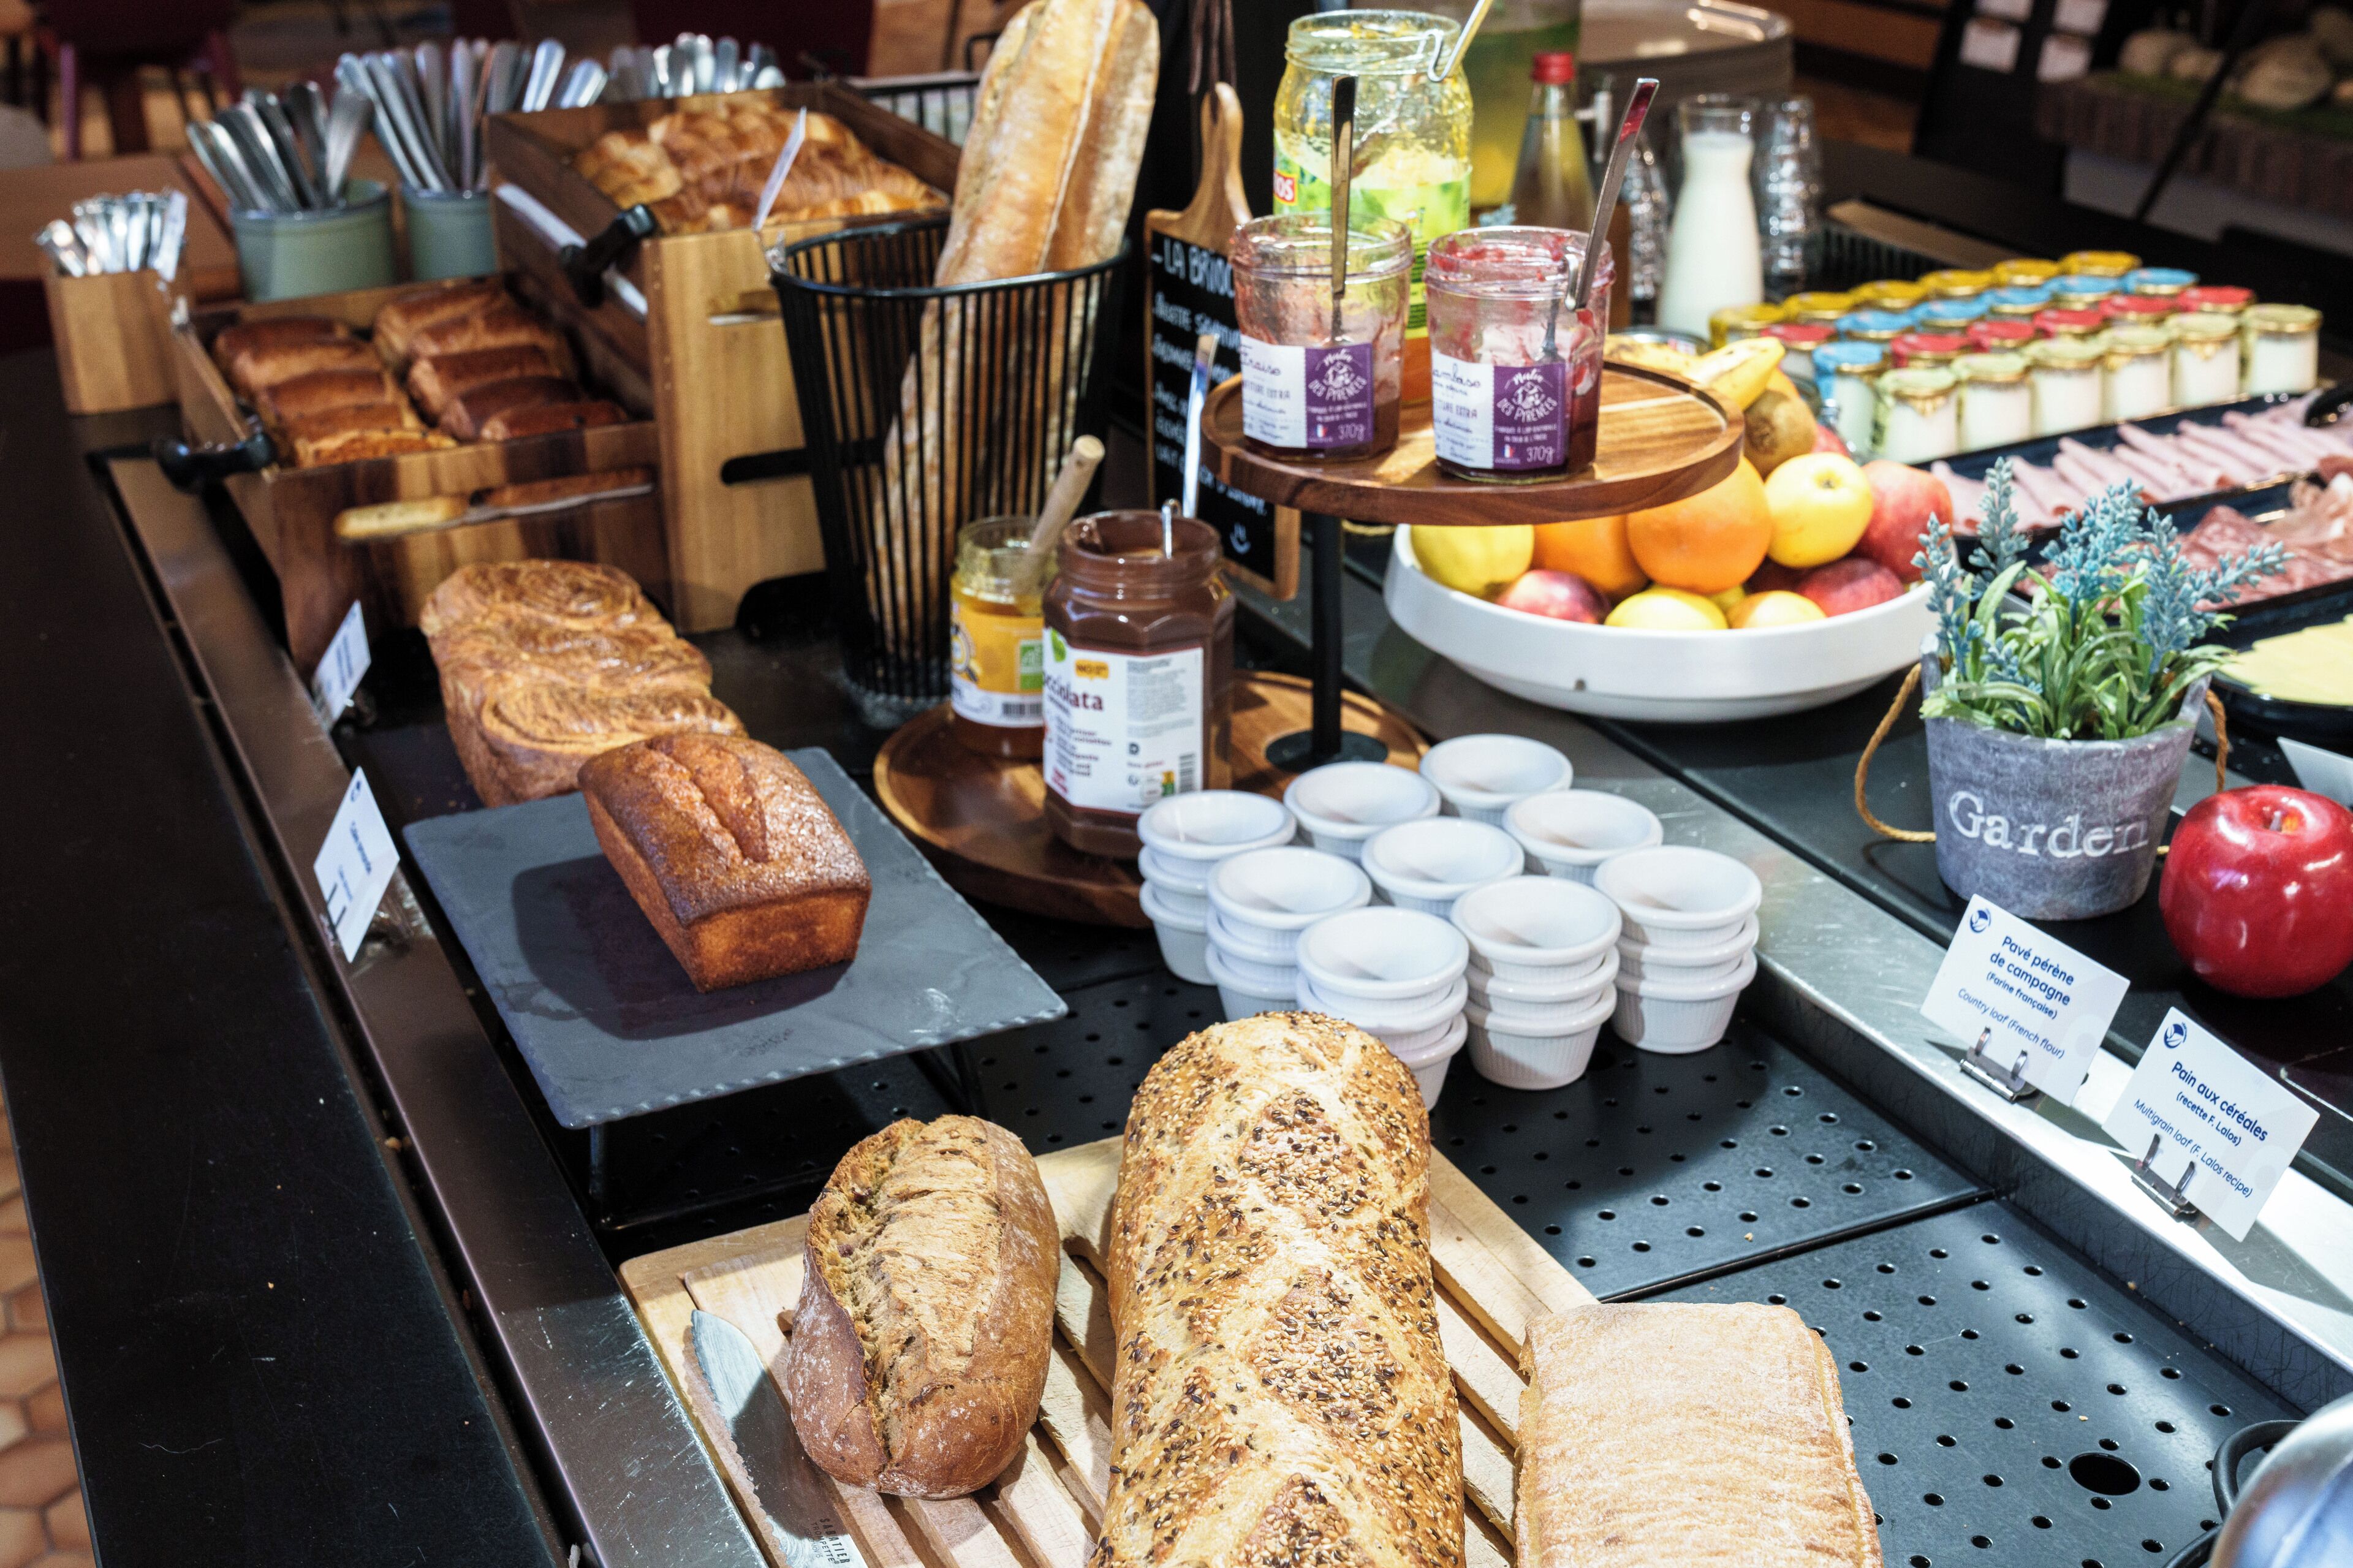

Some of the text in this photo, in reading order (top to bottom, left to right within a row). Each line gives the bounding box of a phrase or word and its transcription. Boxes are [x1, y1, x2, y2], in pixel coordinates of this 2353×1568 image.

[1526, 445, 1555, 464] 370g
[1949, 790, 2148, 858] Garden
[1990, 952, 2071, 1006] de campagne
[2002, 936, 2074, 985] Pavé pérène
[1986, 971, 2058, 1020] (Farine française)
[1958, 988, 2065, 1059] Country loaf (French flour)
[2172, 1061, 2268, 1142] Pain aux céréales
[2176, 1091, 2241, 1146] (recette F. Lalos)
[2134, 1099, 2254, 1199] Multigrain loaf (F. Lalos recipe)
[819, 1518, 851, 1564] SABATIER
